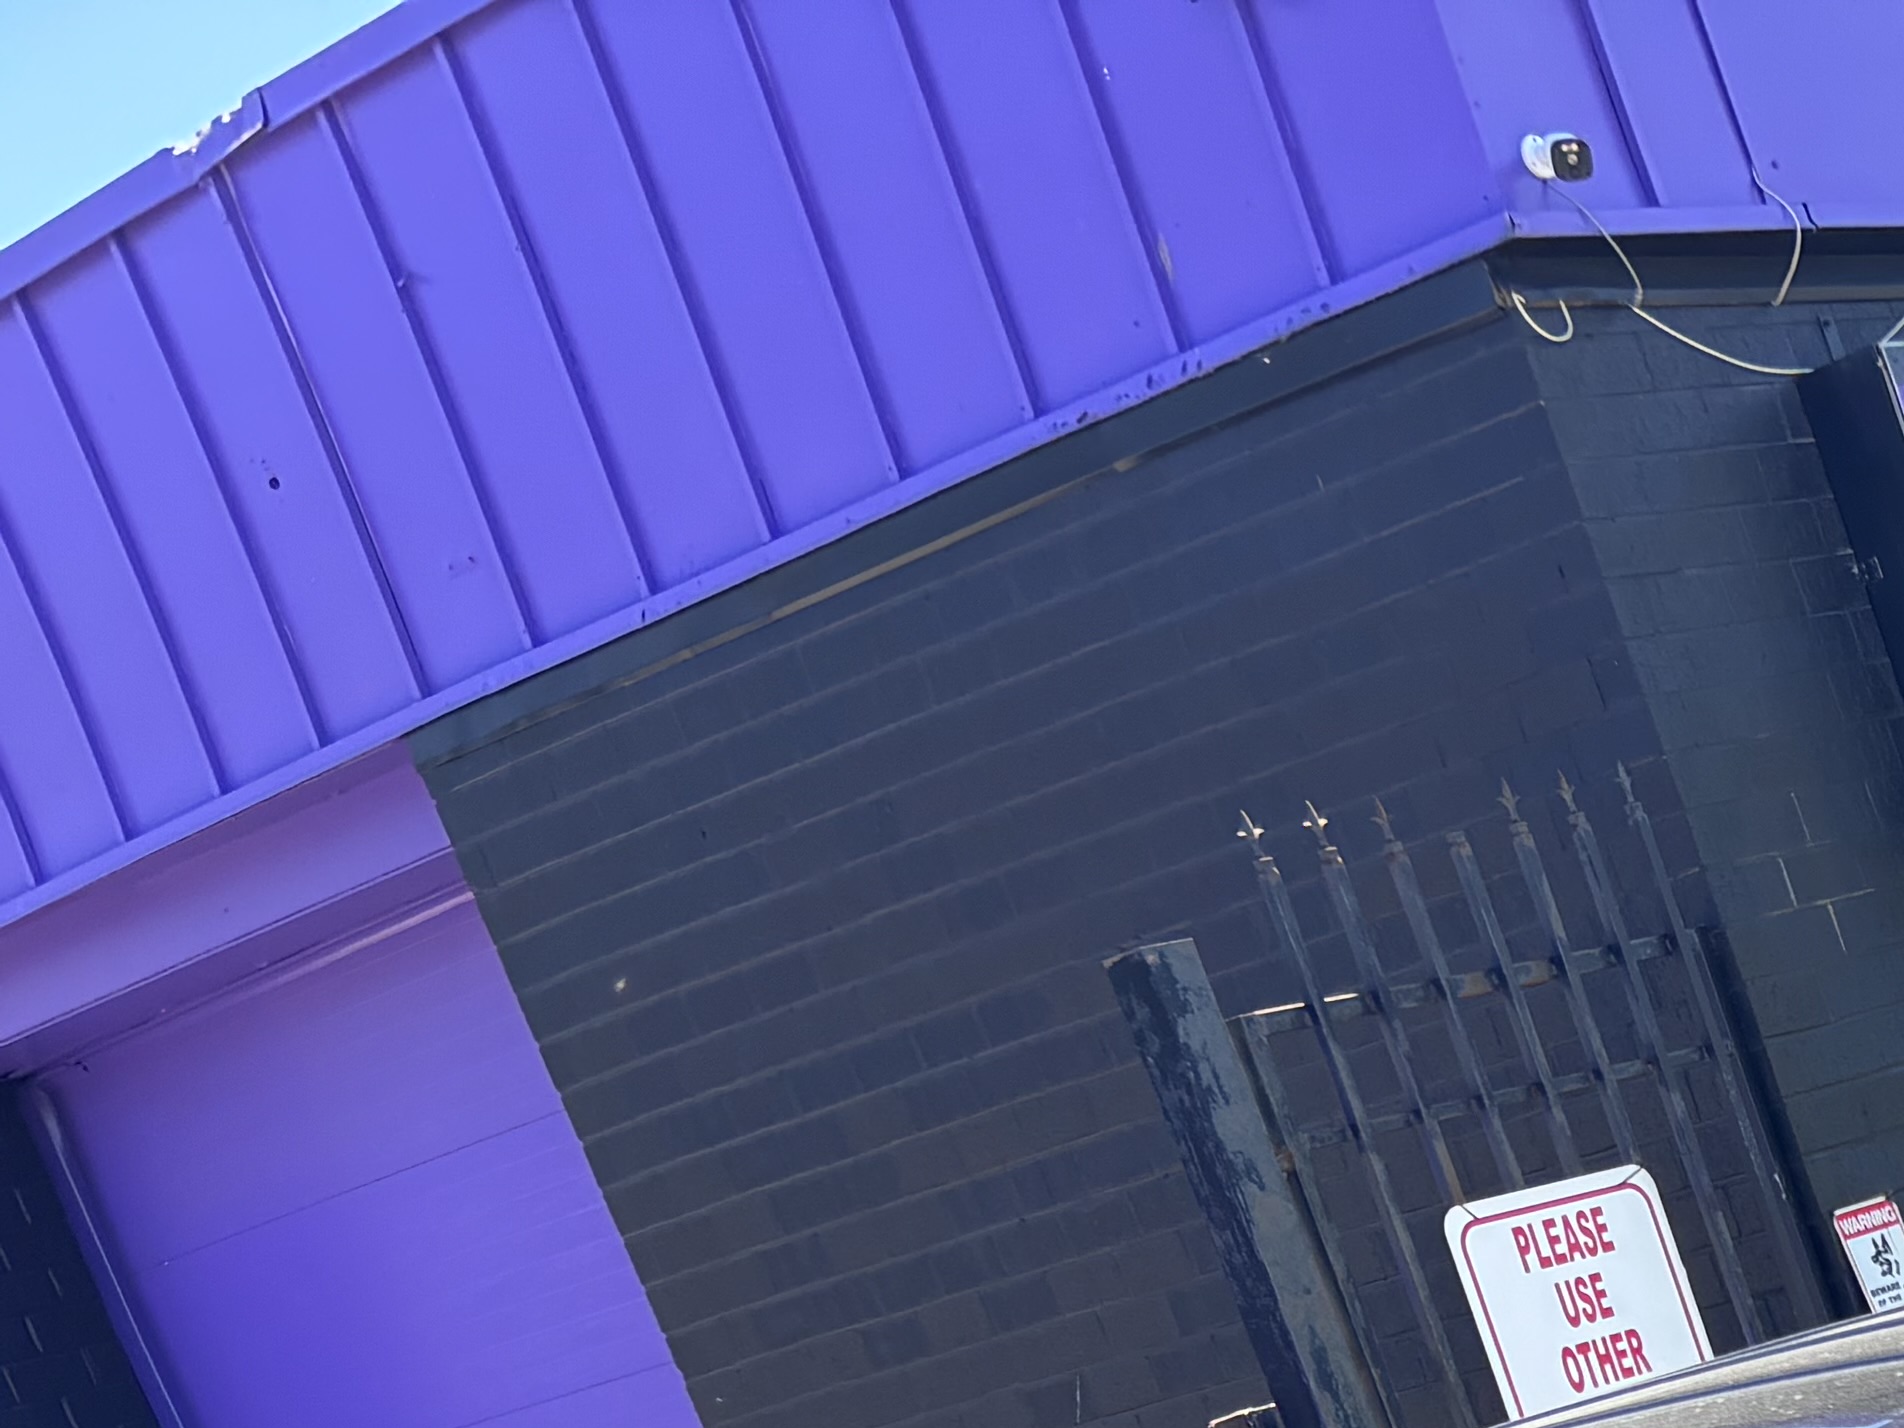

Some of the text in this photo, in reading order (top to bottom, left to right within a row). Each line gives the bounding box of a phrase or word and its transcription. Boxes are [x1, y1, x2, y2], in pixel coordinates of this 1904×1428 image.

[1511, 1205, 1616, 1275] PLEASE
[1838, 1205, 1897, 1236] WARNING
[1554, 1273, 1615, 1329] USE
[1561, 1328, 1653, 1394] OTHER
